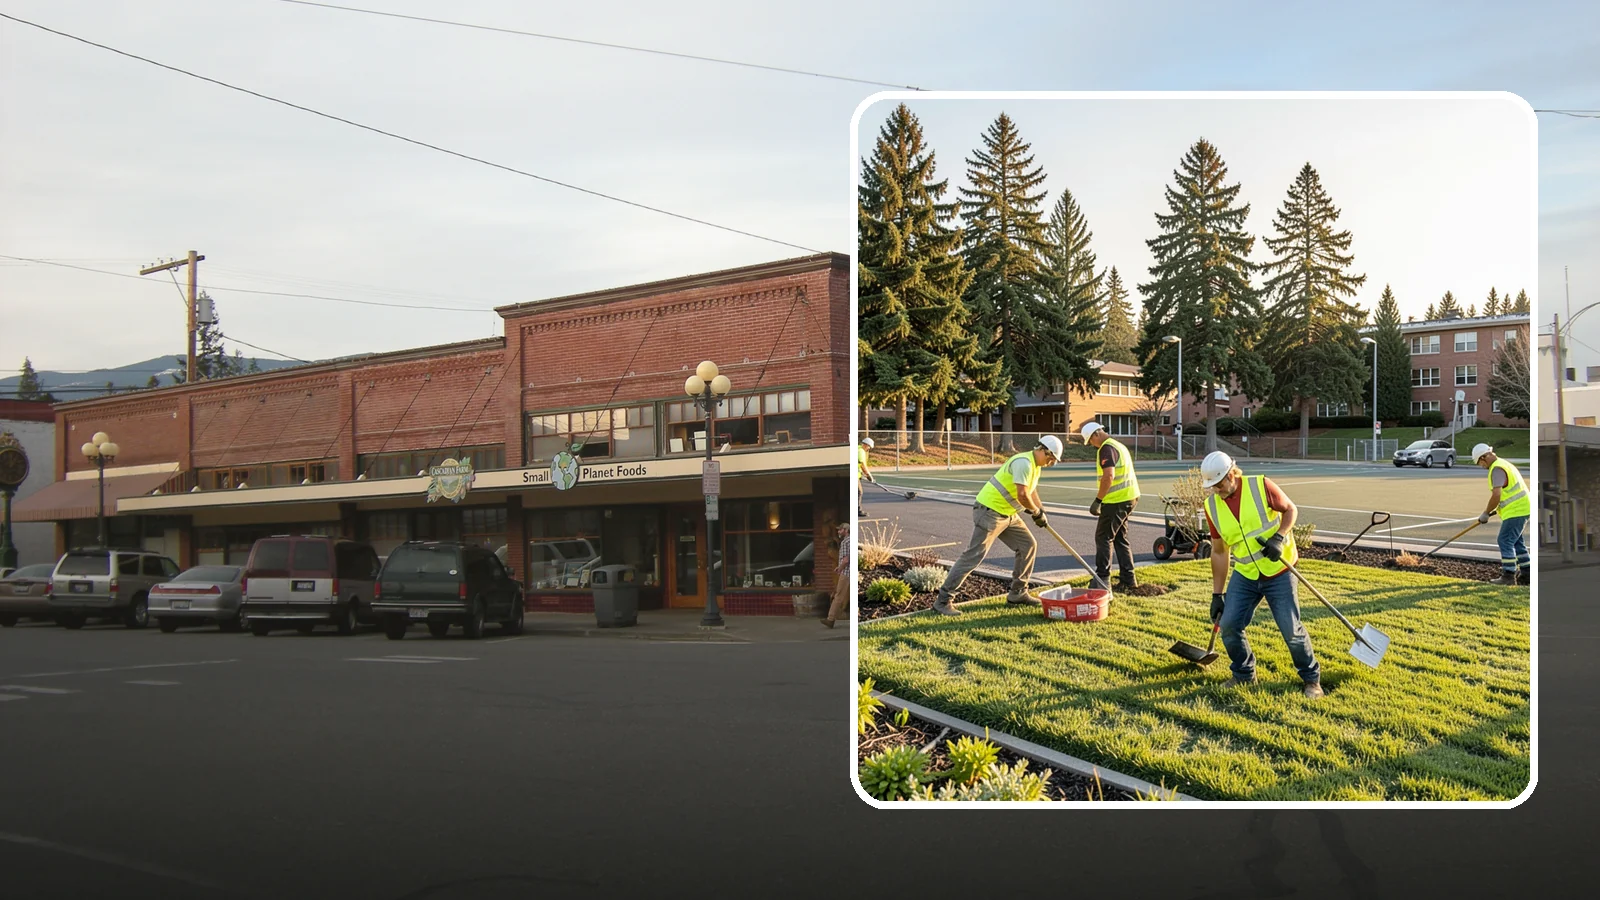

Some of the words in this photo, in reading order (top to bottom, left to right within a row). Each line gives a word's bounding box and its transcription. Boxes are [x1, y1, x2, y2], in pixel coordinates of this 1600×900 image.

[523, 471, 549, 483] Small
[583, 467, 614, 479] Planet
[617, 464, 647, 477] Foods
